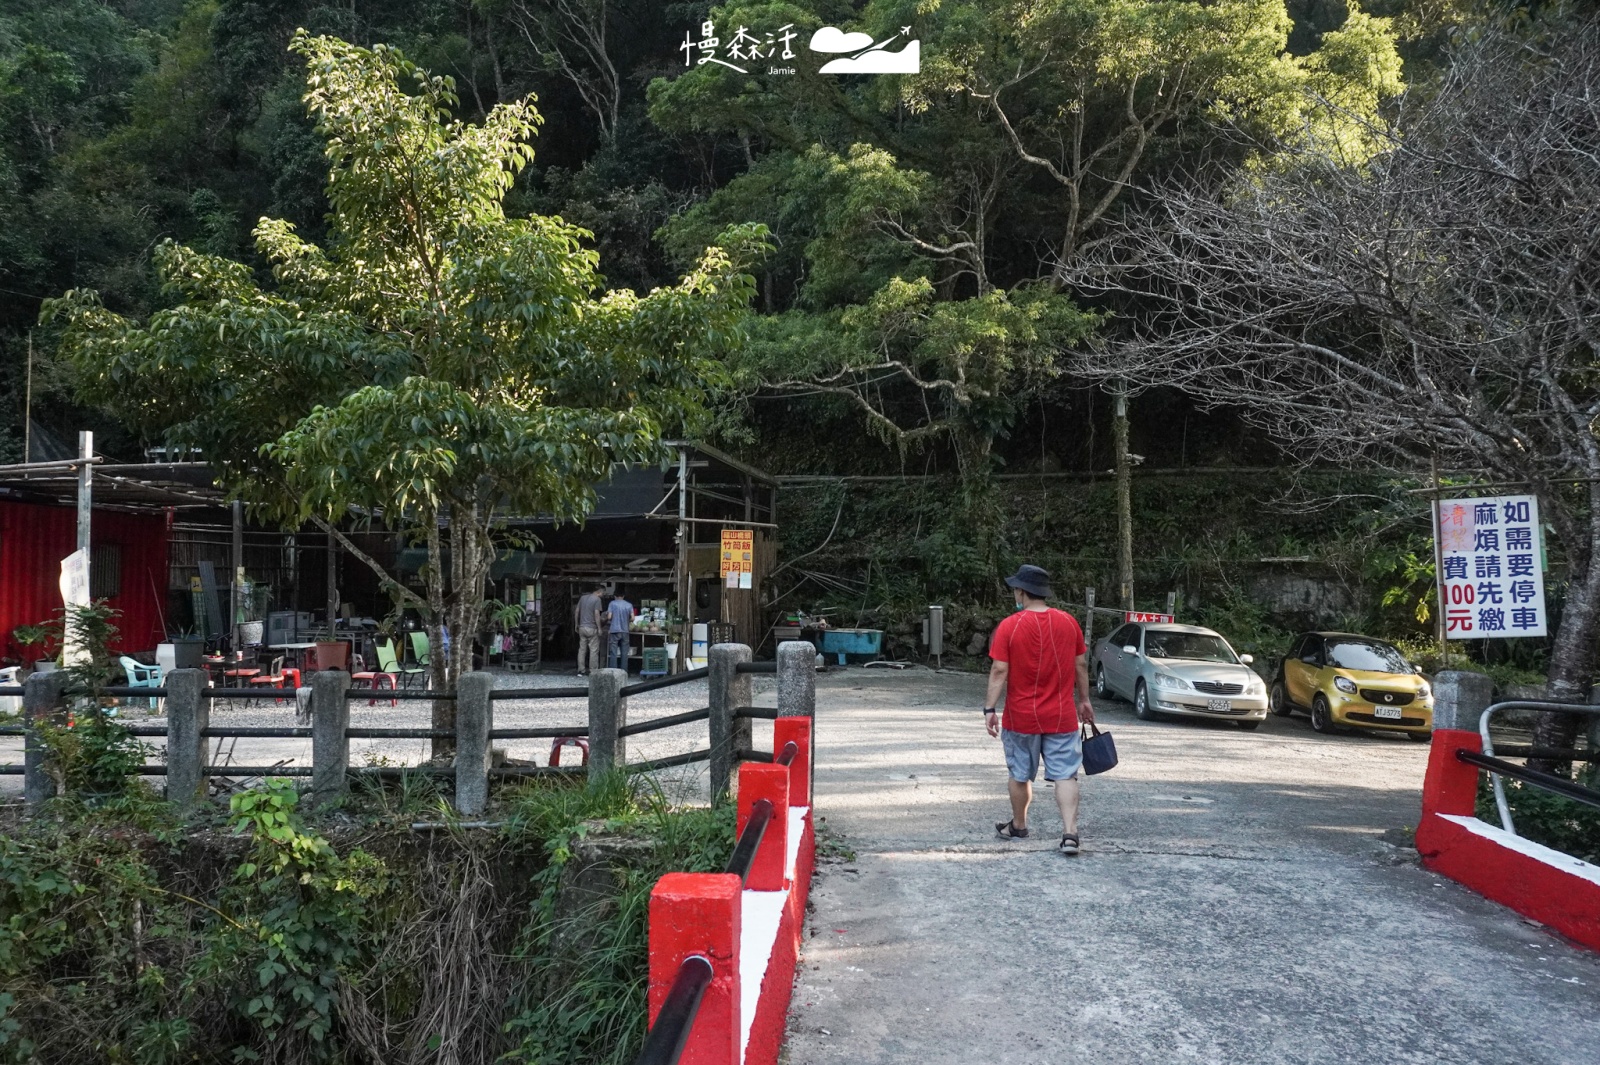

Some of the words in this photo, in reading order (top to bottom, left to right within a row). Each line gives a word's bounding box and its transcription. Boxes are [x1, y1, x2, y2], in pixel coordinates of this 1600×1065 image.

[722, 541, 751, 550] 竹筒飯
[1474, 502, 1506, 631] 麻煩請先繳
[1503, 501, 1539, 631] 如需要停車
